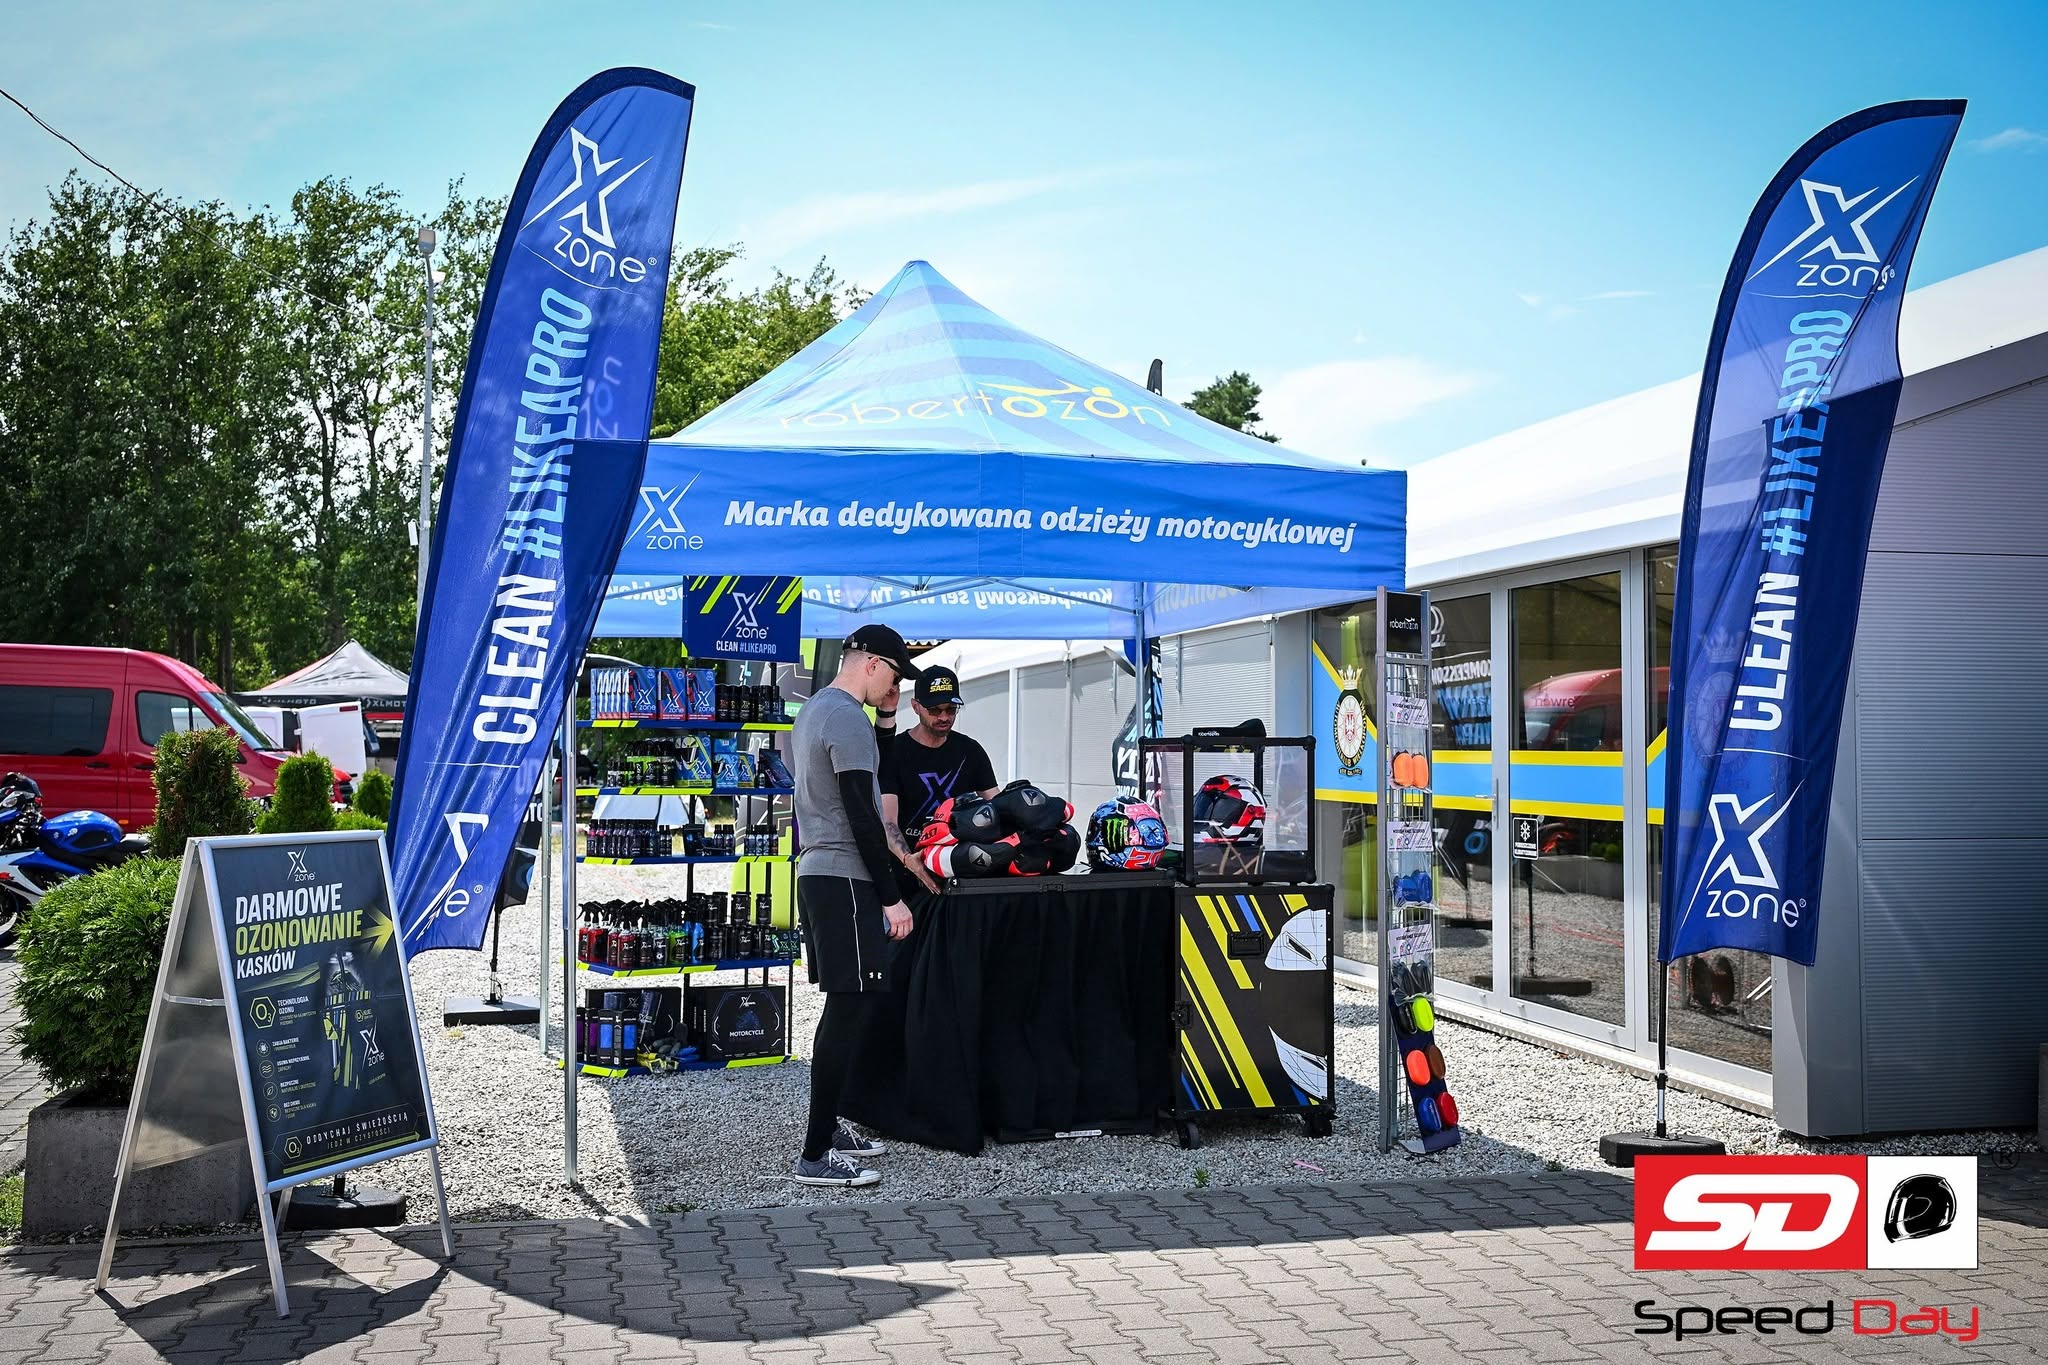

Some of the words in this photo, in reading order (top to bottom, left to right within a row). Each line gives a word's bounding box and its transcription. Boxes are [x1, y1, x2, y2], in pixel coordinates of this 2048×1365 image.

[503, 287, 593, 560] #LIKEAPRO
[780, 389, 1172, 430] robertozon
[646, 533, 704, 551] zone
[723, 500, 830, 527] Marka
[837, 501, 1033, 535] dedykowana
[1039, 506, 1152, 543] odzieży
[1156, 516, 1358, 553] motocyklowej
[473, 574, 557, 744] CLEAN
[716, 640, 739, 652] CLEAN
[740, 642, 777, 654] #LIKEAPRO
[1729, 572, 1800, 731] CLEAN
[235, 883, 343, 925] DARMOWE
[235, 909, 364, 956] OZONOWANIE
[236, 949, 297, 980] KASKÓW
[729, 1029, 765, 1038] MOTORCYCLE
[306, 1125, 351, 1145] ODDYCHAJ
